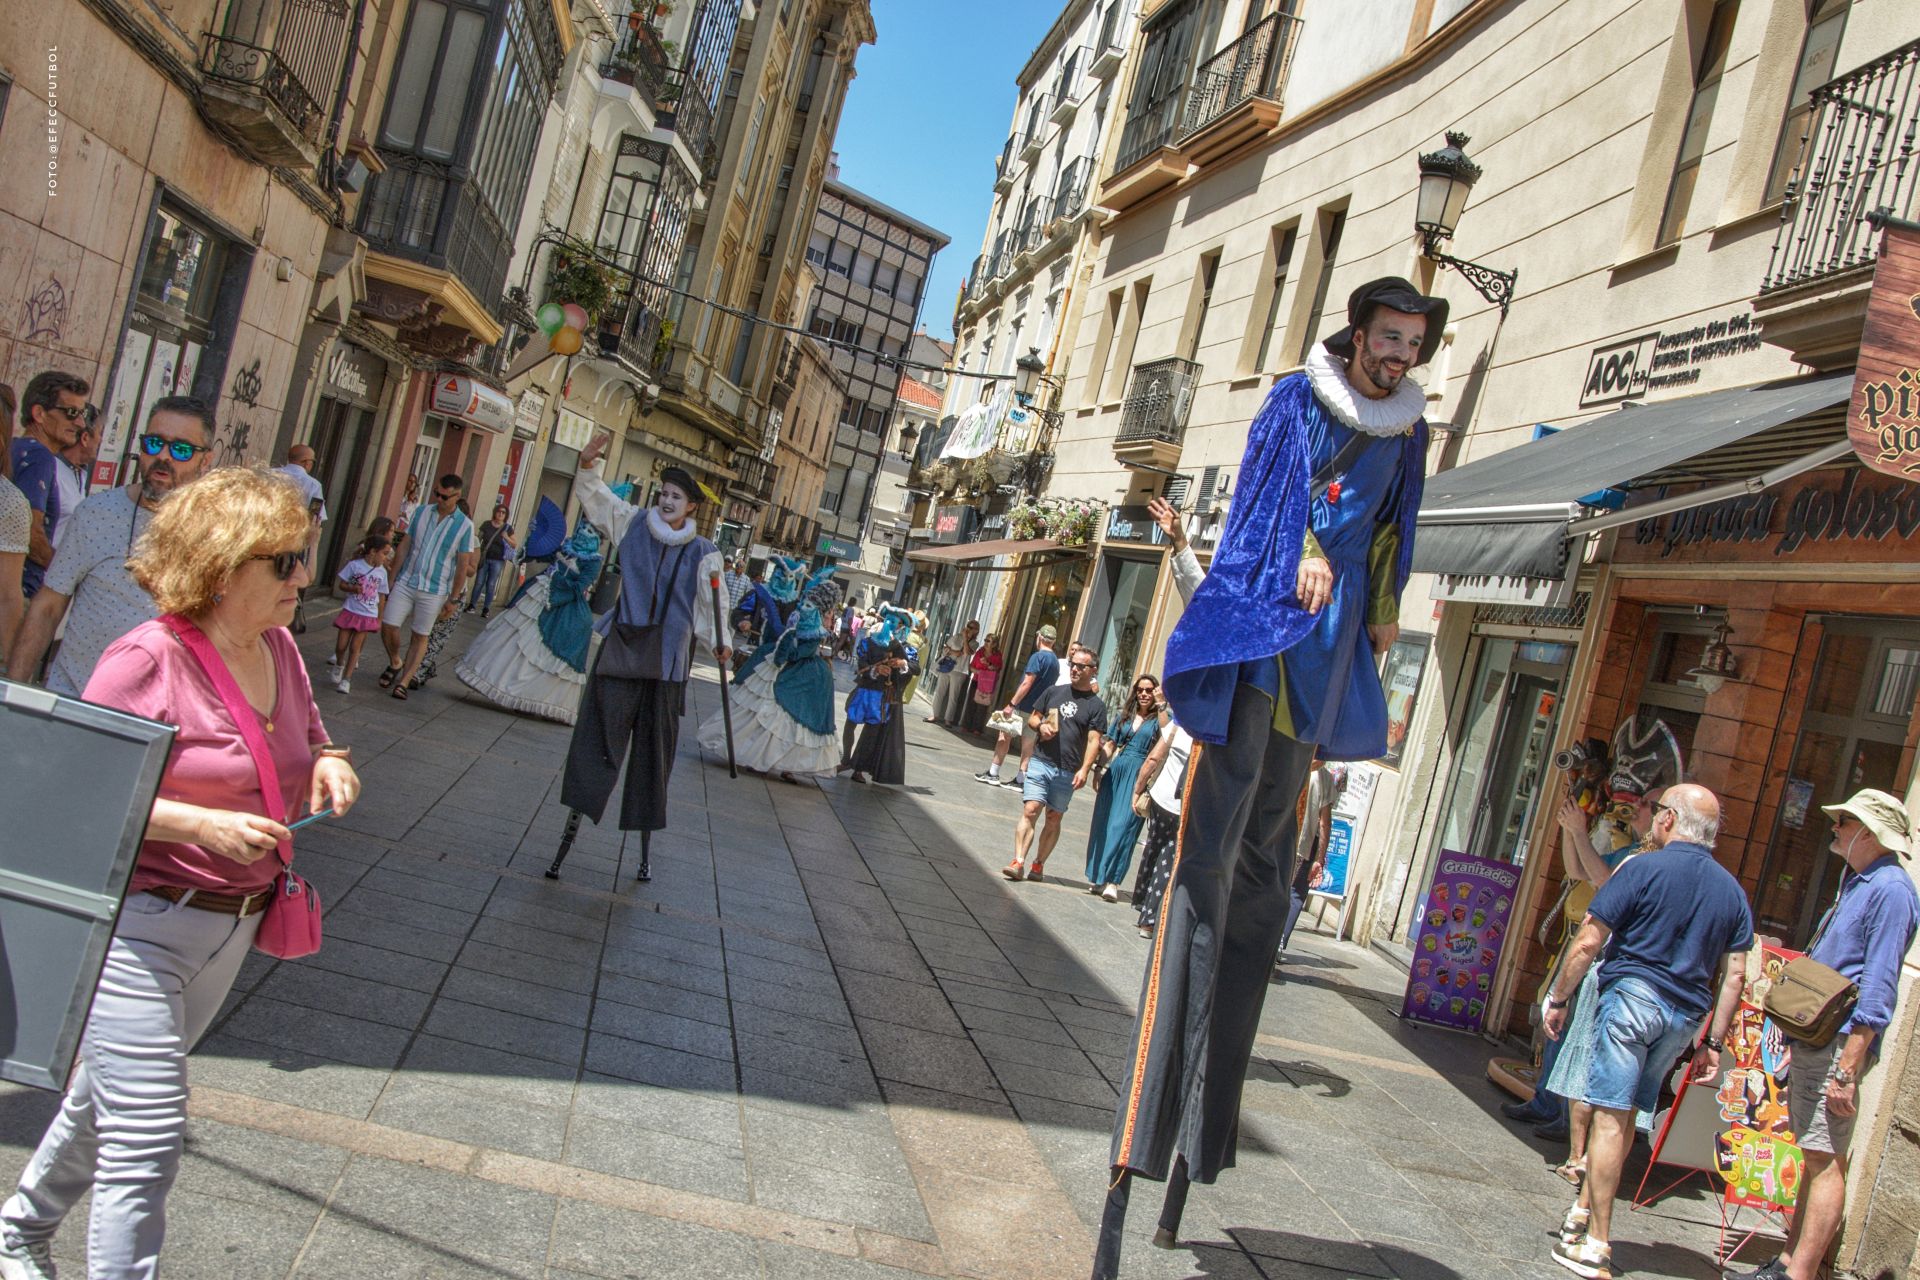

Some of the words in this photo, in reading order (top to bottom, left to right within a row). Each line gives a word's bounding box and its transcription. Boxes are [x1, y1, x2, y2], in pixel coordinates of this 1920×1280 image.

[1586, 350, 1635, 396] AOC
[1013, 409, 1025, 418] NO
[1442, 860, 1517, 889] Granizados
[1771, 963, 1779, 972] M
